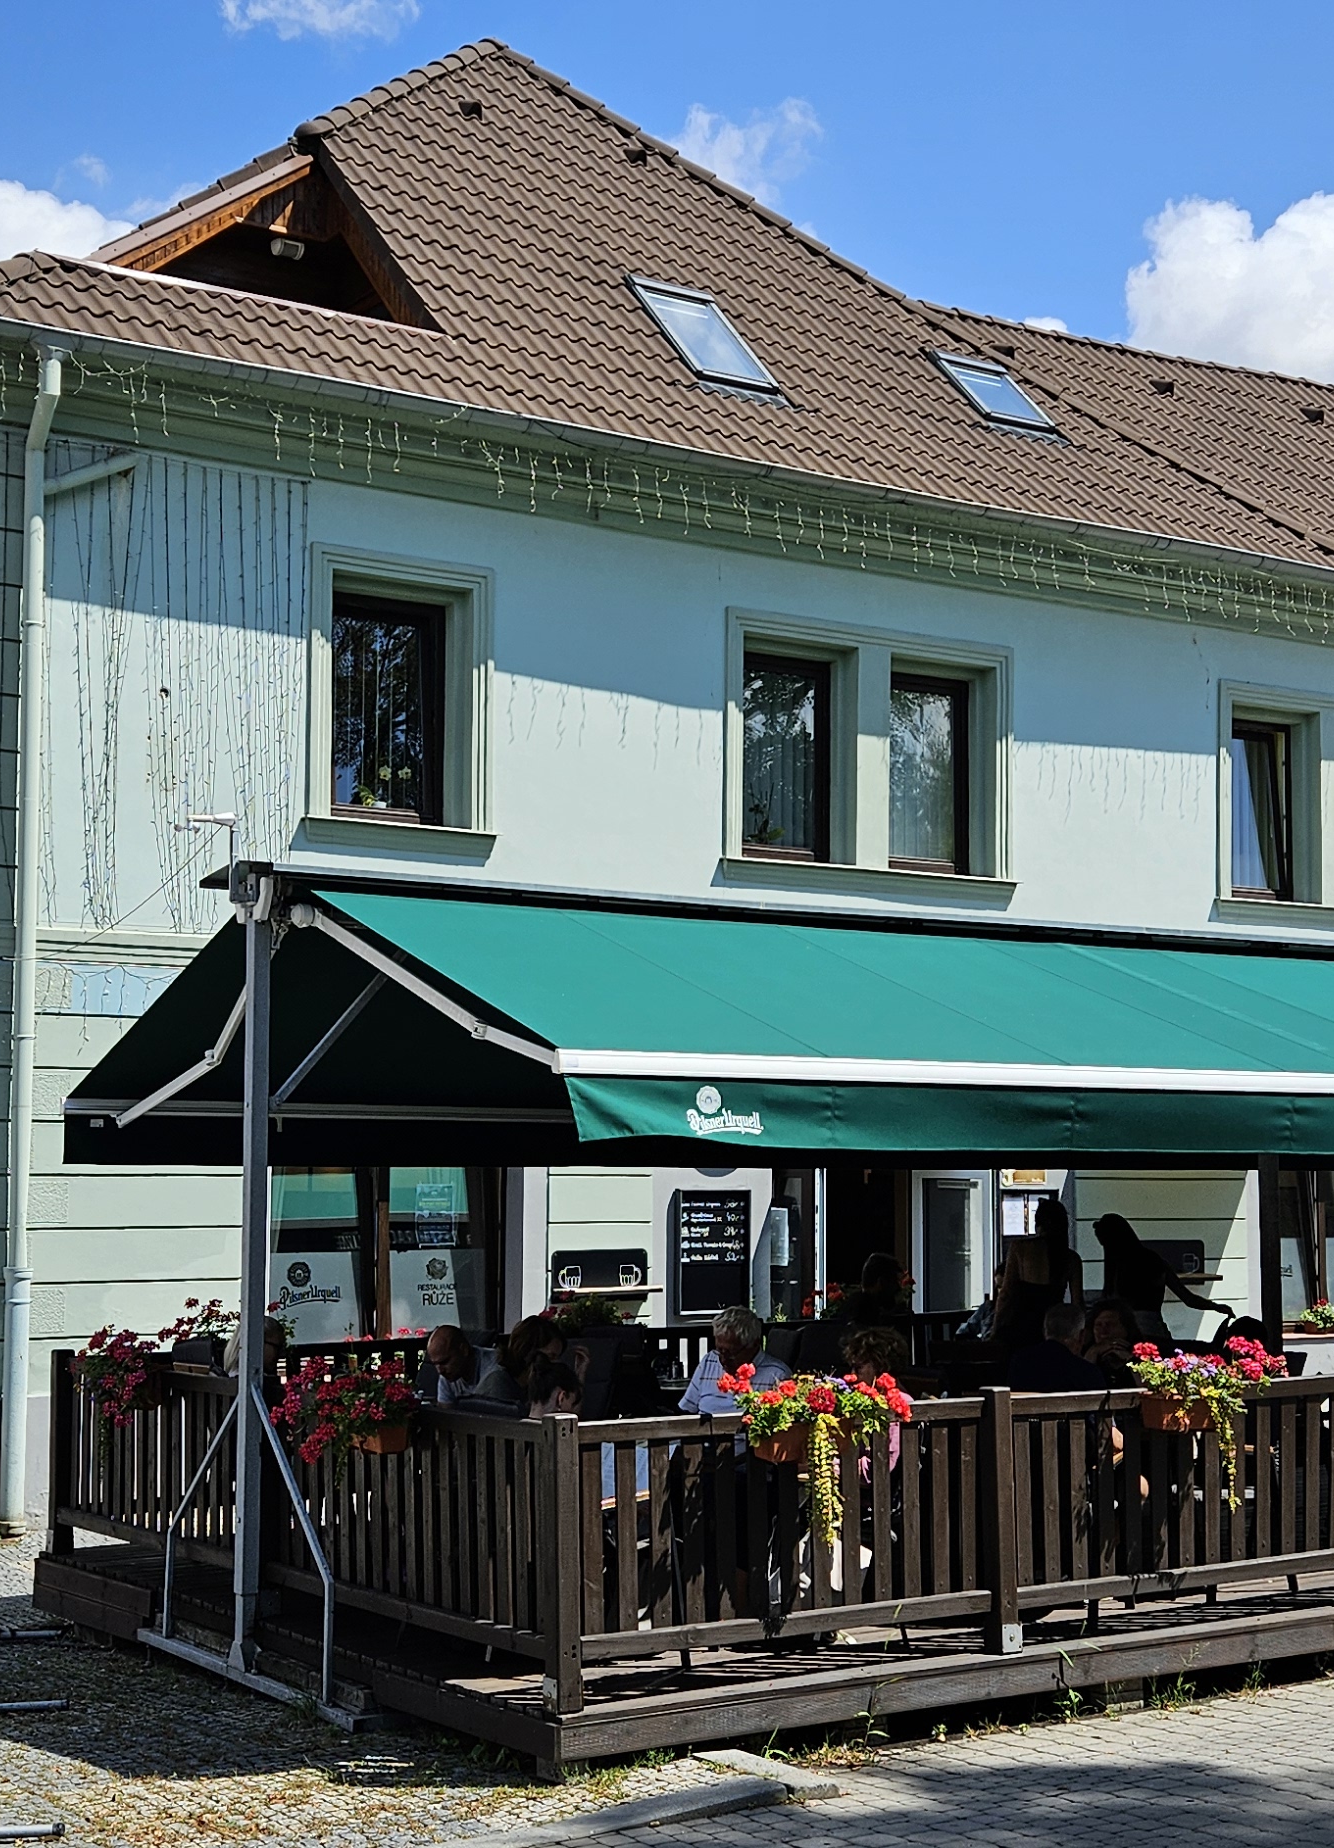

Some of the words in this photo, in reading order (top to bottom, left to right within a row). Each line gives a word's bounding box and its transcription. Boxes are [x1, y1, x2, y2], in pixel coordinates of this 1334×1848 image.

[686, 1108, 724, 1136] Pilsner
[722, 1107, 764, 1135] Urquell
[279, 1286, 310, 1309] Pilsner
[309, 1284, 341, 1303] Urquell
[422, 1290, 454, 1306] RŮŽE
